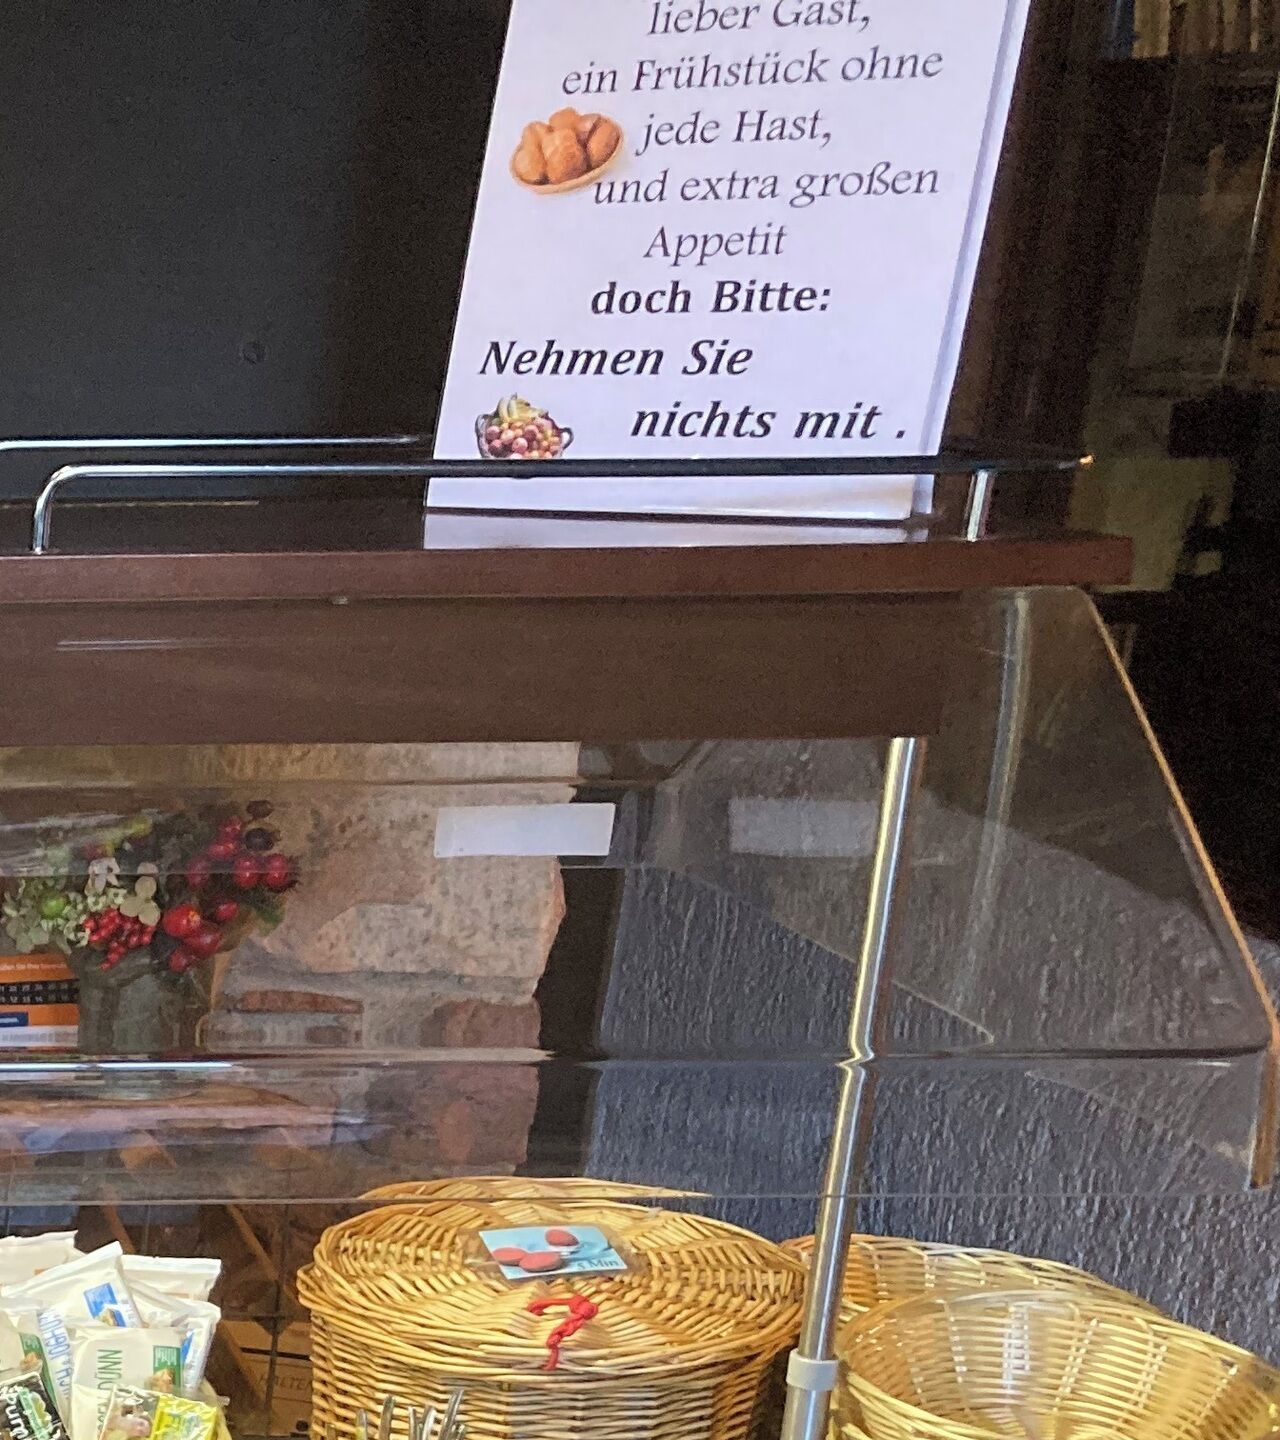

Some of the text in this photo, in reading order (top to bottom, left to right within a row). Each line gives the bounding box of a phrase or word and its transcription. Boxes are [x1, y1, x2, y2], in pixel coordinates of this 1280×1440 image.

[646, 0, 871, 36] lieber Gast,
[562, 45, 944, 94] ein Frühstück ohne
[634, 108, 832, 156] jede Hast,
[594, 160, 940, 209] und extra großen
[642, 221, 788, 267] Appetit
[590, 279, 832, 316] doch Bitte:
[477, 337, 754, 377] Nehmen Sie
[629, 399, 777, 439] nichts
[792, 401, 883, 439] mit
